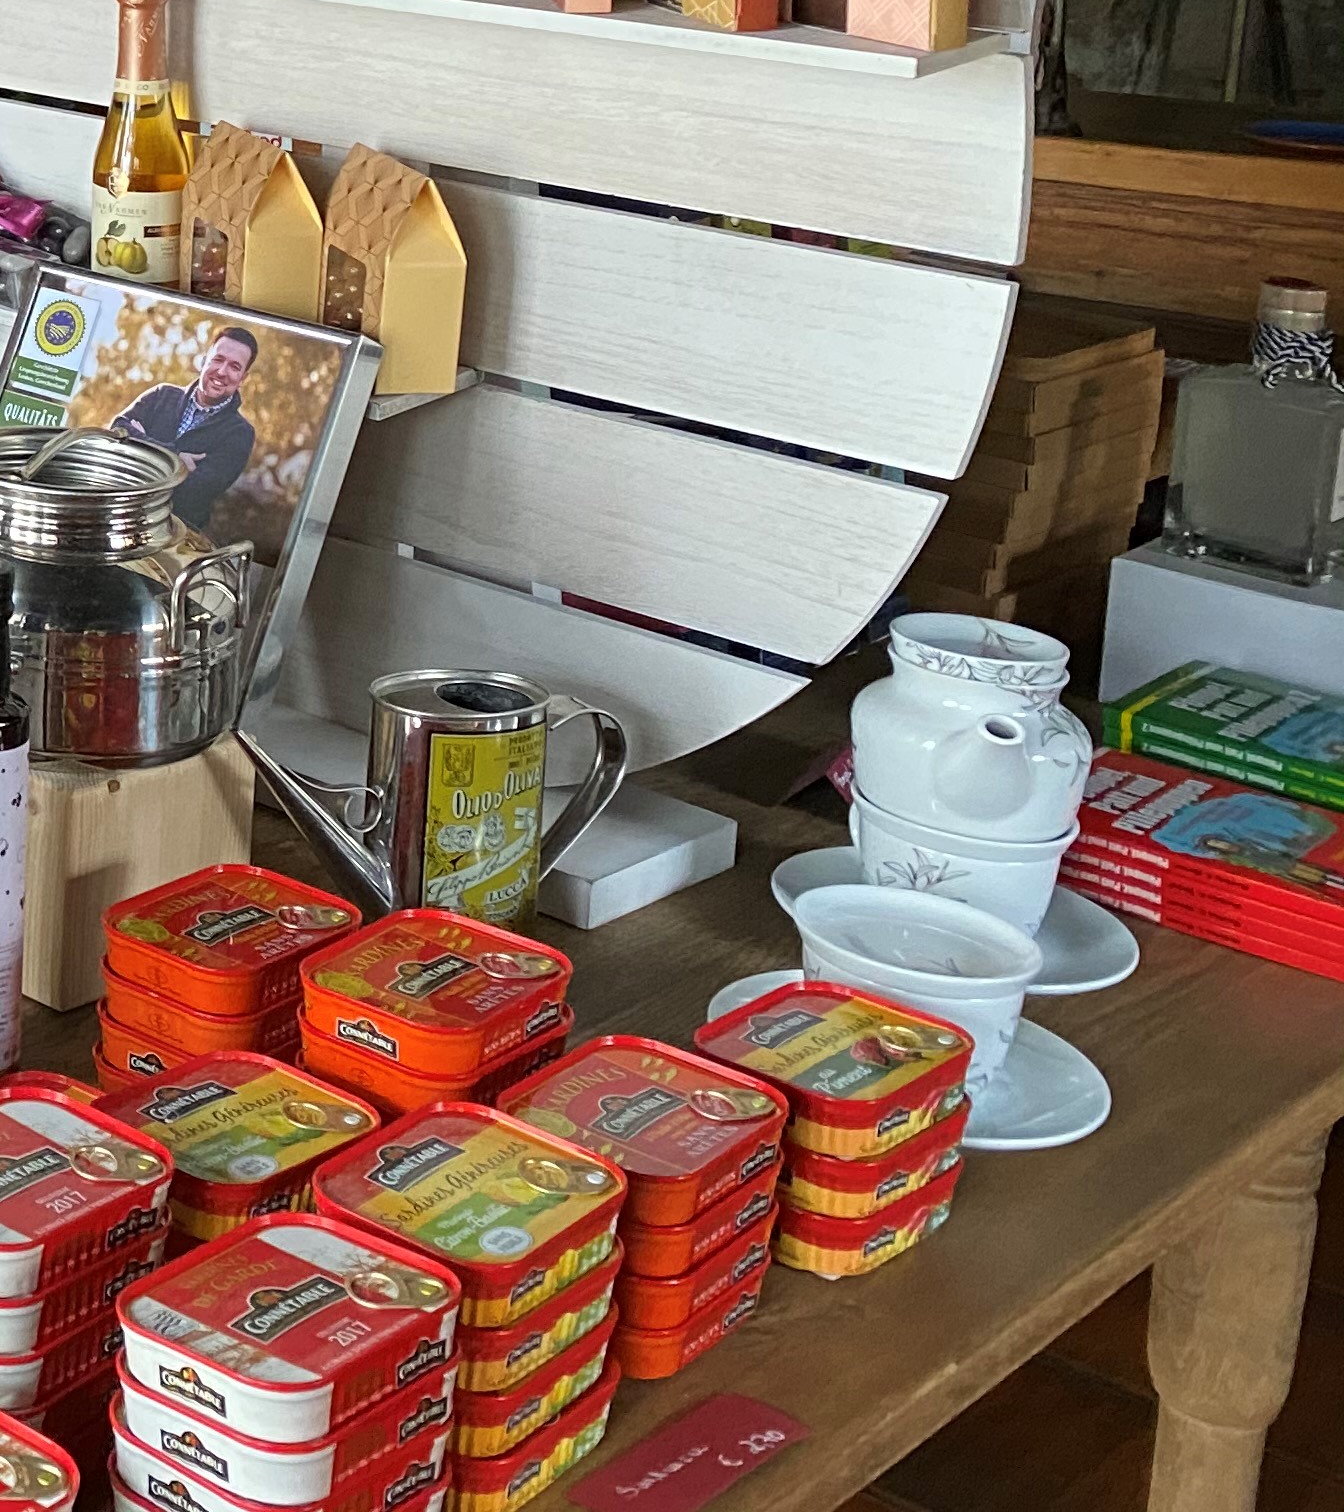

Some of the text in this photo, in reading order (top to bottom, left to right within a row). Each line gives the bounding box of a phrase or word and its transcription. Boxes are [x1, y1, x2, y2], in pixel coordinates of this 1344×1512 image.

[504, 767, 542, 800] OLIVA
[488, 874, 527, 902] LUCCA
[46, 1190, 88, 1214] 2017
[328, 1319, 373, 1348] 2017
